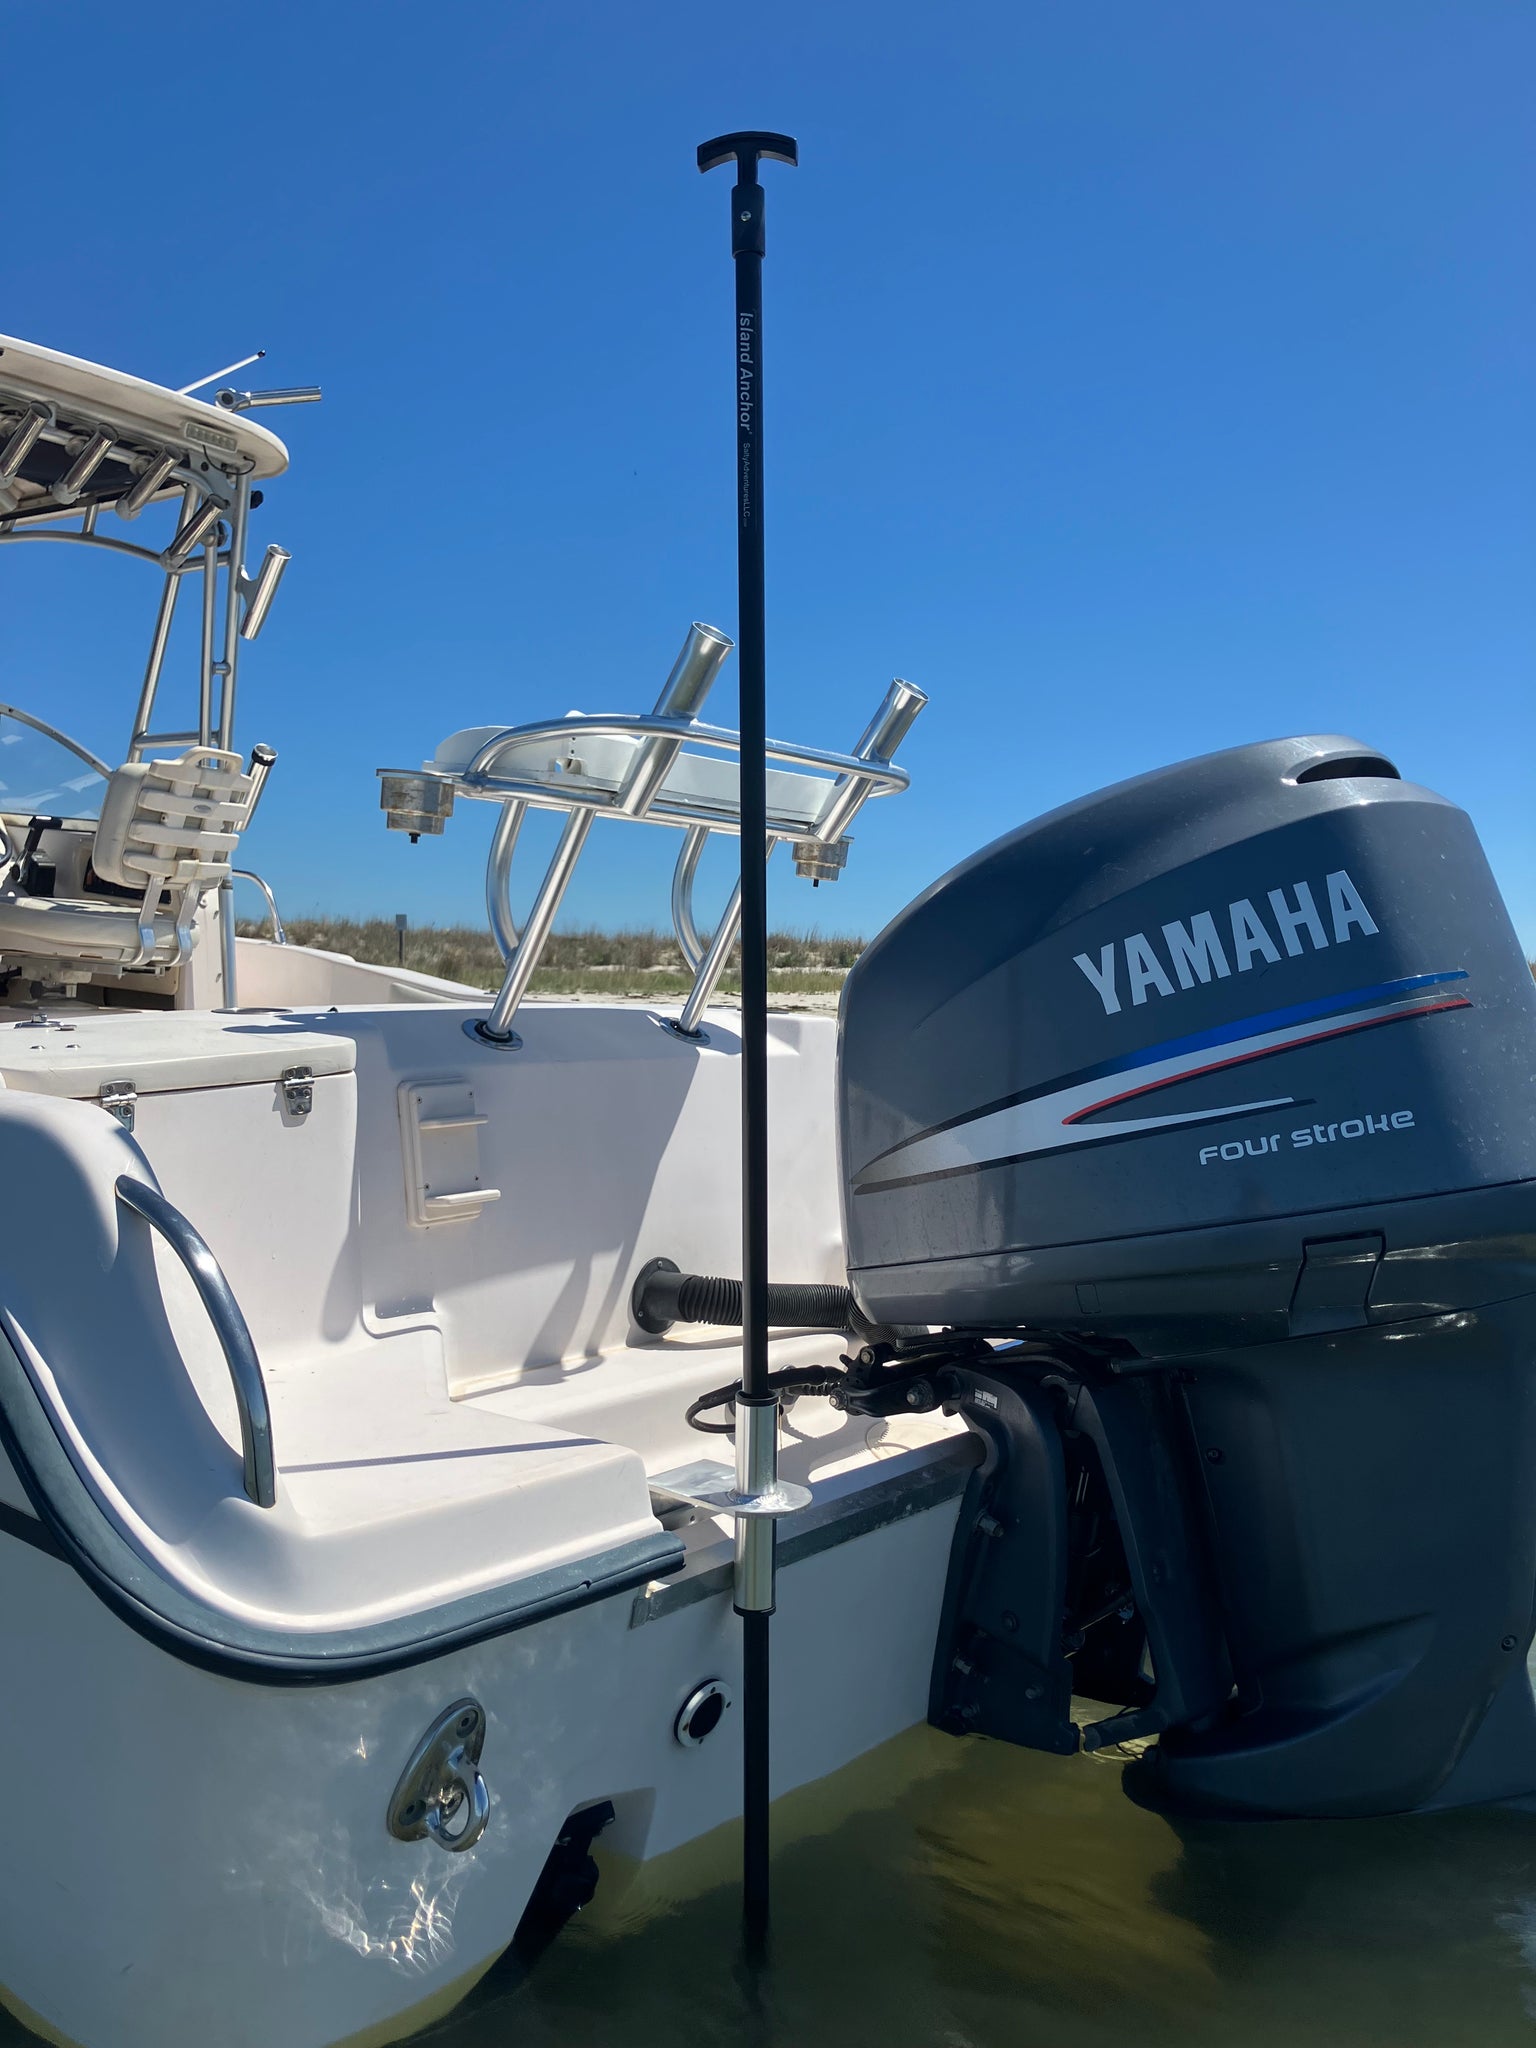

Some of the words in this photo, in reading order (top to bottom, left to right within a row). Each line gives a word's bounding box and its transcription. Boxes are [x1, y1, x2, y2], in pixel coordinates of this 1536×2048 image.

[740, 312, 754, 364] Island
[740, 367, 754, 431] Anchor
[1072, 869, 1380, 1015] YAMAHA
